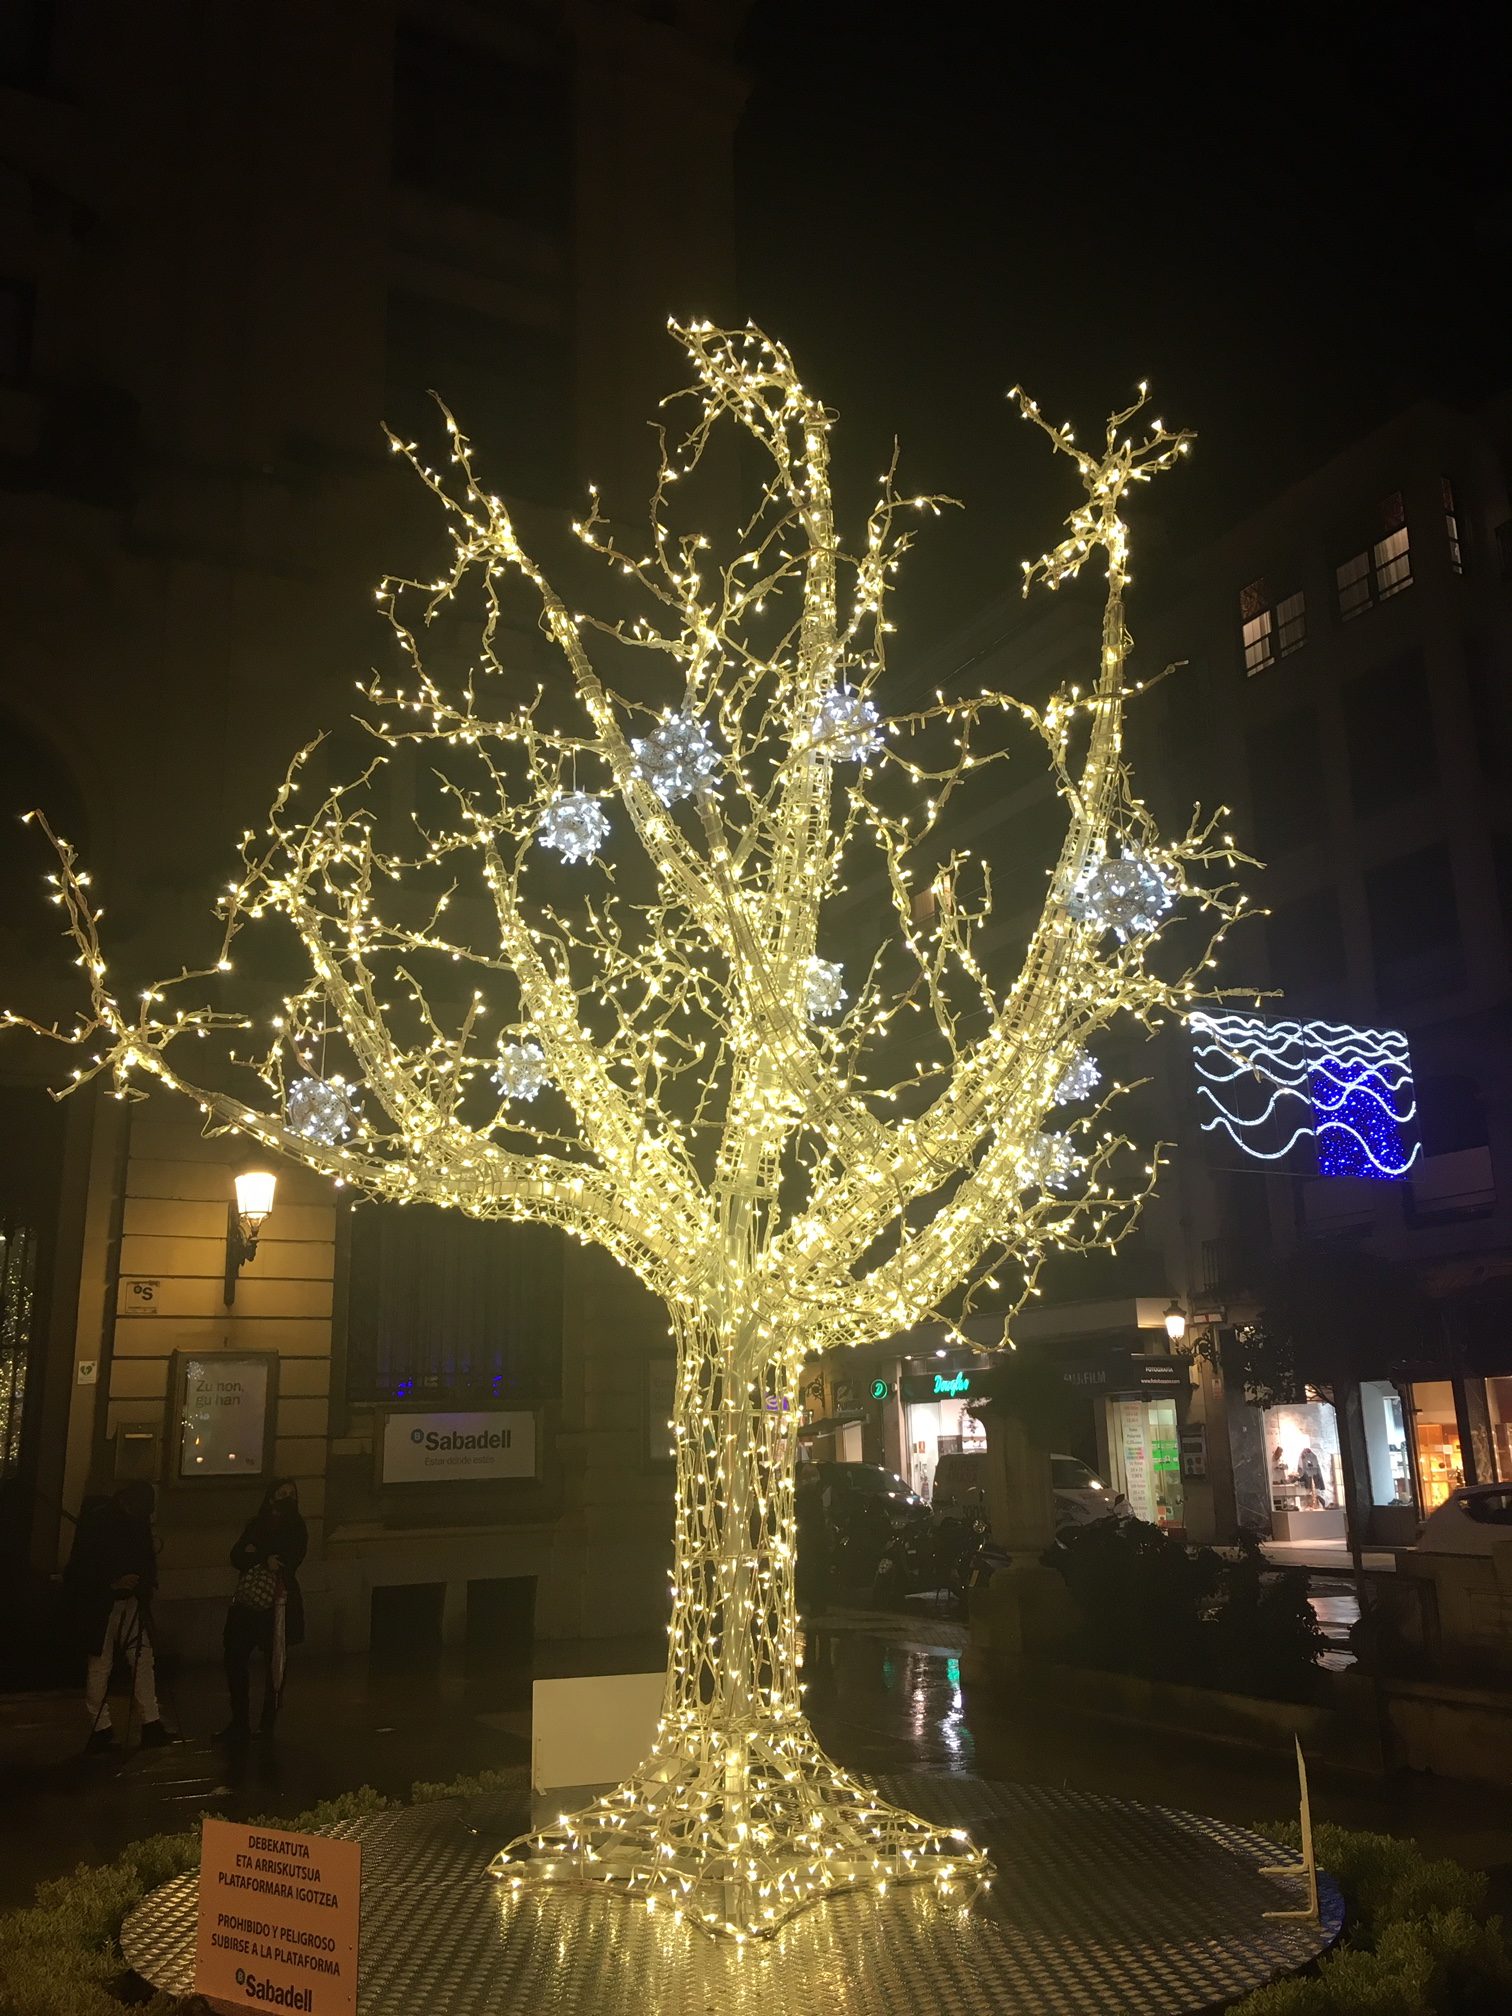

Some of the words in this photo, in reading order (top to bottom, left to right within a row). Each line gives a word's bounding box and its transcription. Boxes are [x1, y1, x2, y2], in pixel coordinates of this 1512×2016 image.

[196, 1380, 213, 1392] Zu
[195, 1395, 213, 1408] gu
[215, 1394, 241, 1406] han
[425, 1428, 512, 1451] Sabadell
[248, 1834, 310, 1859] DEBEKATUTA
[235, 1854, 254, 1869] ETA
[254, 1856, 321, 1882] ARRISKUTSUA
[218, 1871, 293, 1899] PLATAFORMARA
[295, 1887, 339, 1909] IGOTZEA
[217, 1913, 270, 1938] PROHIBIDO
[271, 1925, 279, 1938] Y
[280, 1926, 336, 1952] PELIGROSO
[211, 1932, 250, 1954] SUBIRSE
[251, 1942, 259, 1955] A
[260, 1945, 273, 1959] LA
[274, 1947, 341, 1977] PLATAFORMA
[245, 1973, 313, 2013] Sabadell
